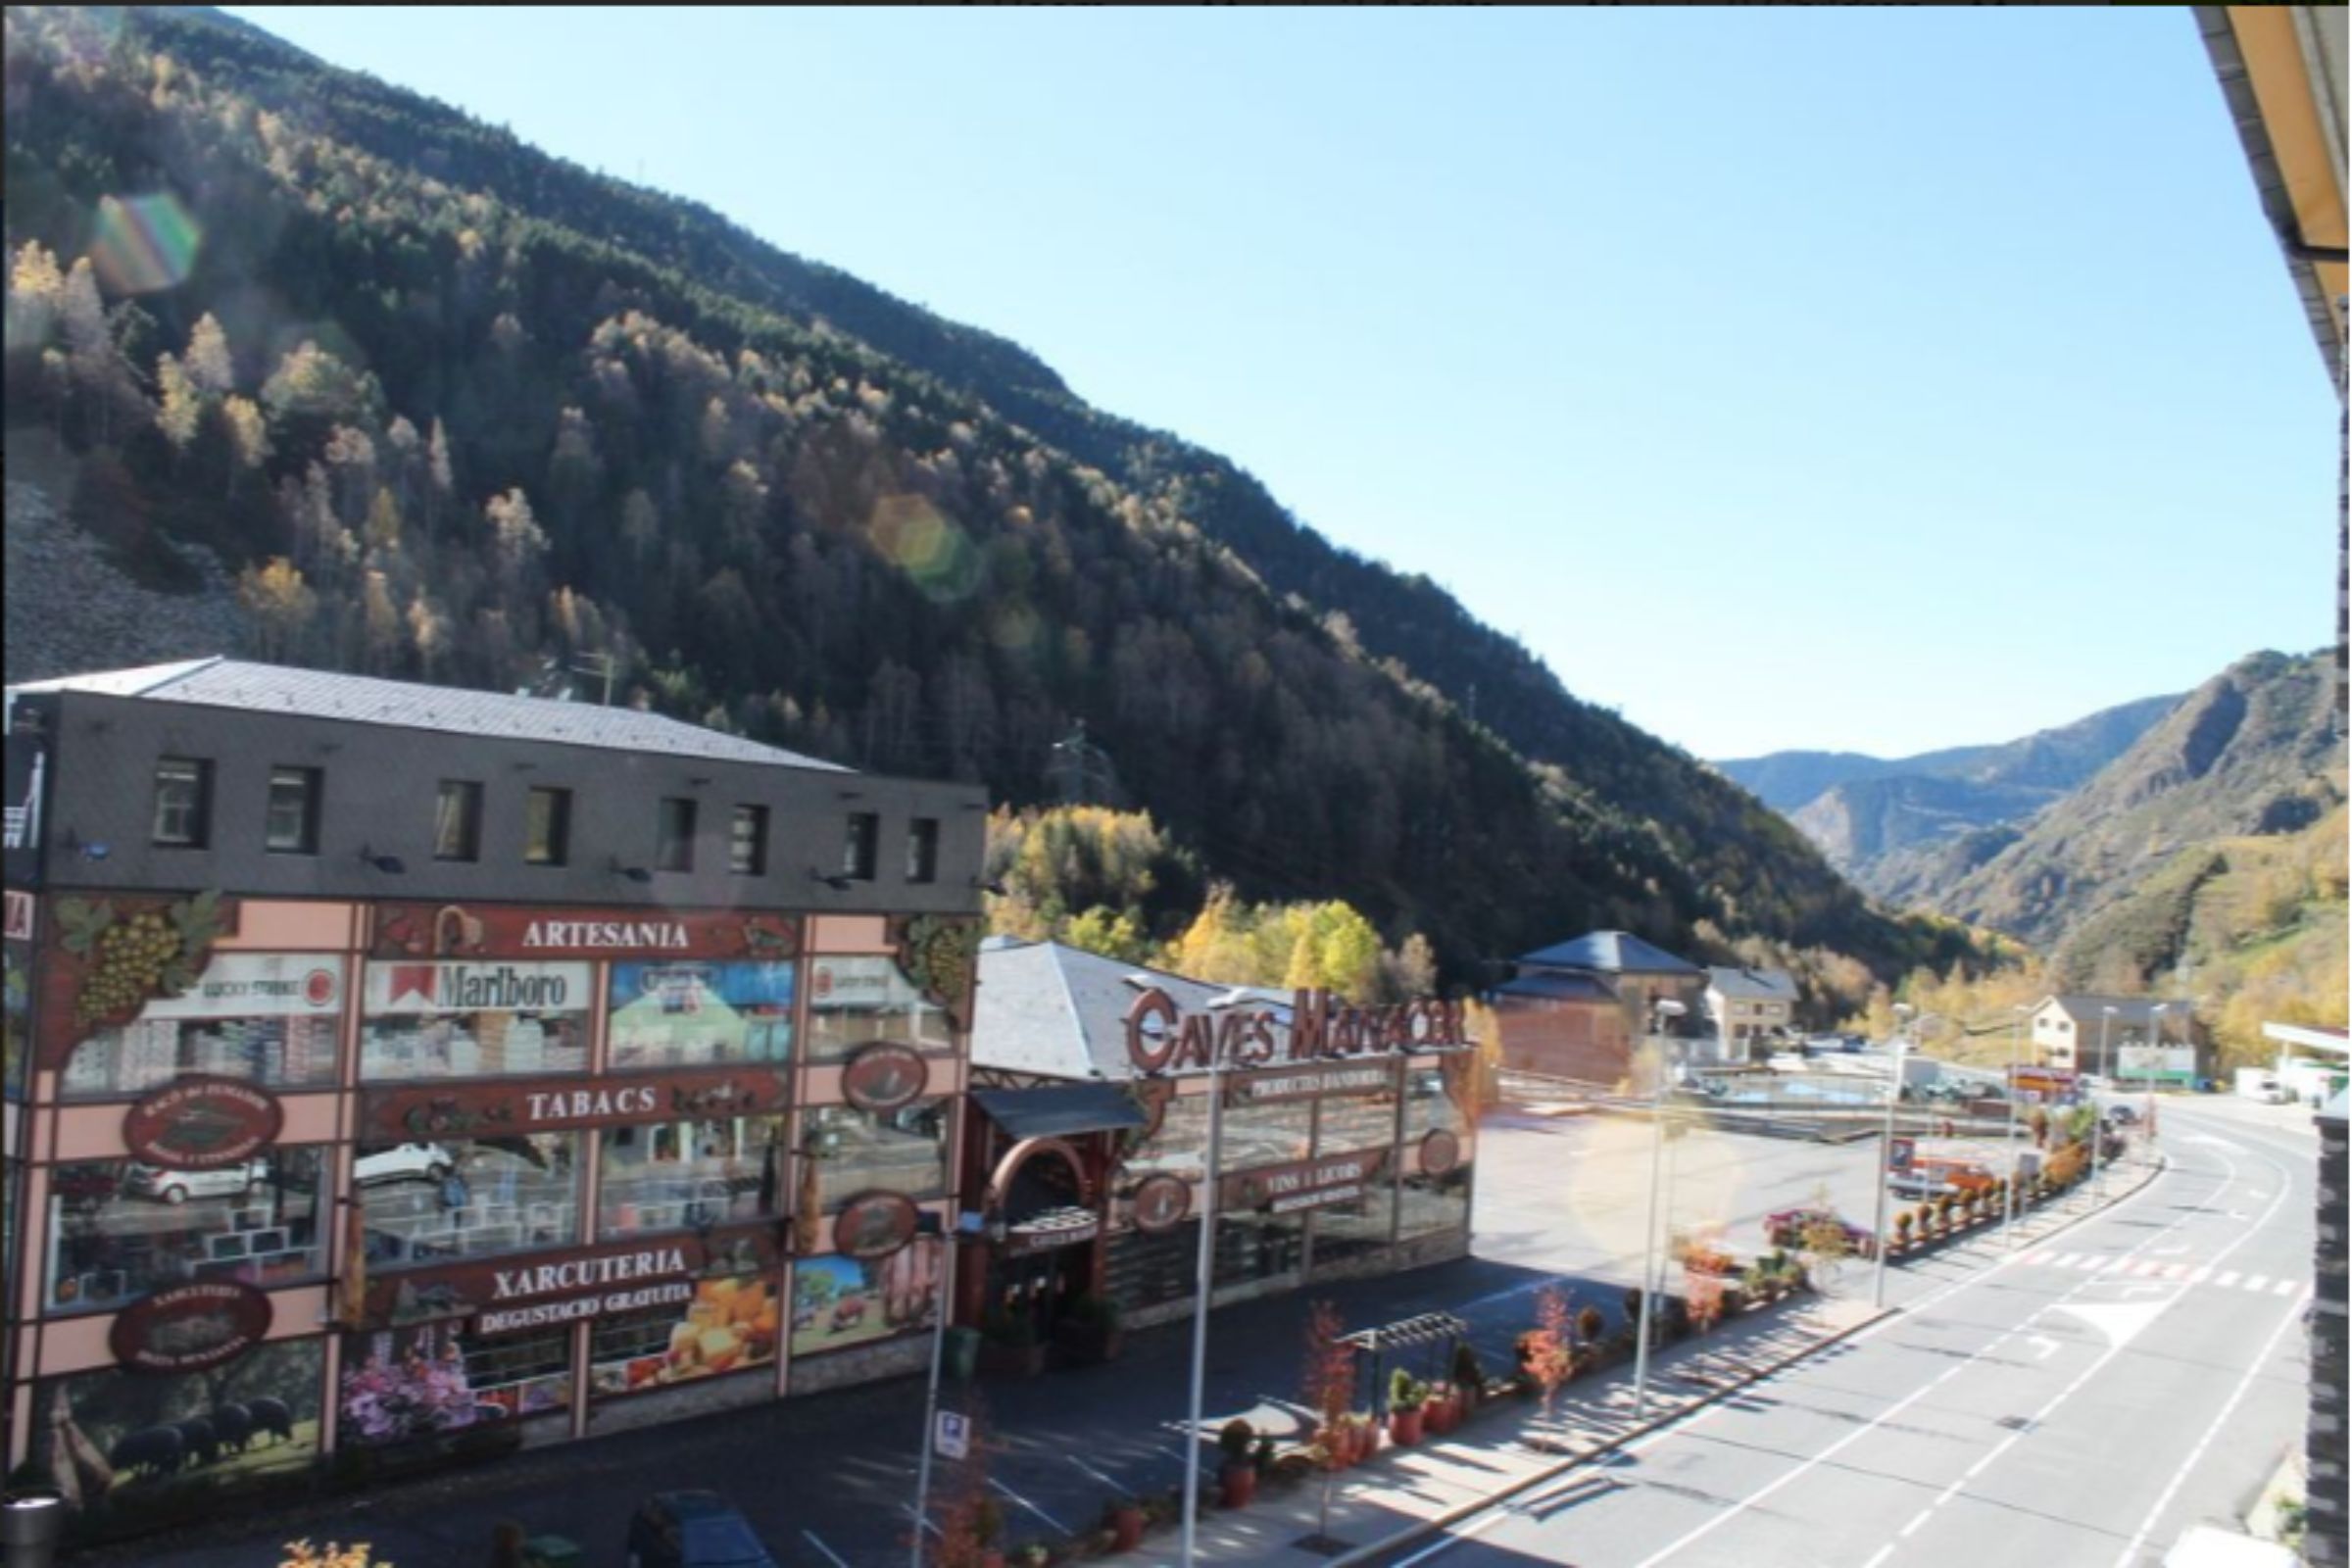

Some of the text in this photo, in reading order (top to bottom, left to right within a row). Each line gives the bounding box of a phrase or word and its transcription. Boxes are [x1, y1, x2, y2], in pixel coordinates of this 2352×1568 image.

[521, 919, 689, 949] ARTESANIA
[437, 963, 567, 1007] Marlboro
[526, 1087, 656, 1120] TABACS
[492, 1248, 685, 1299] XARCUTERIA
